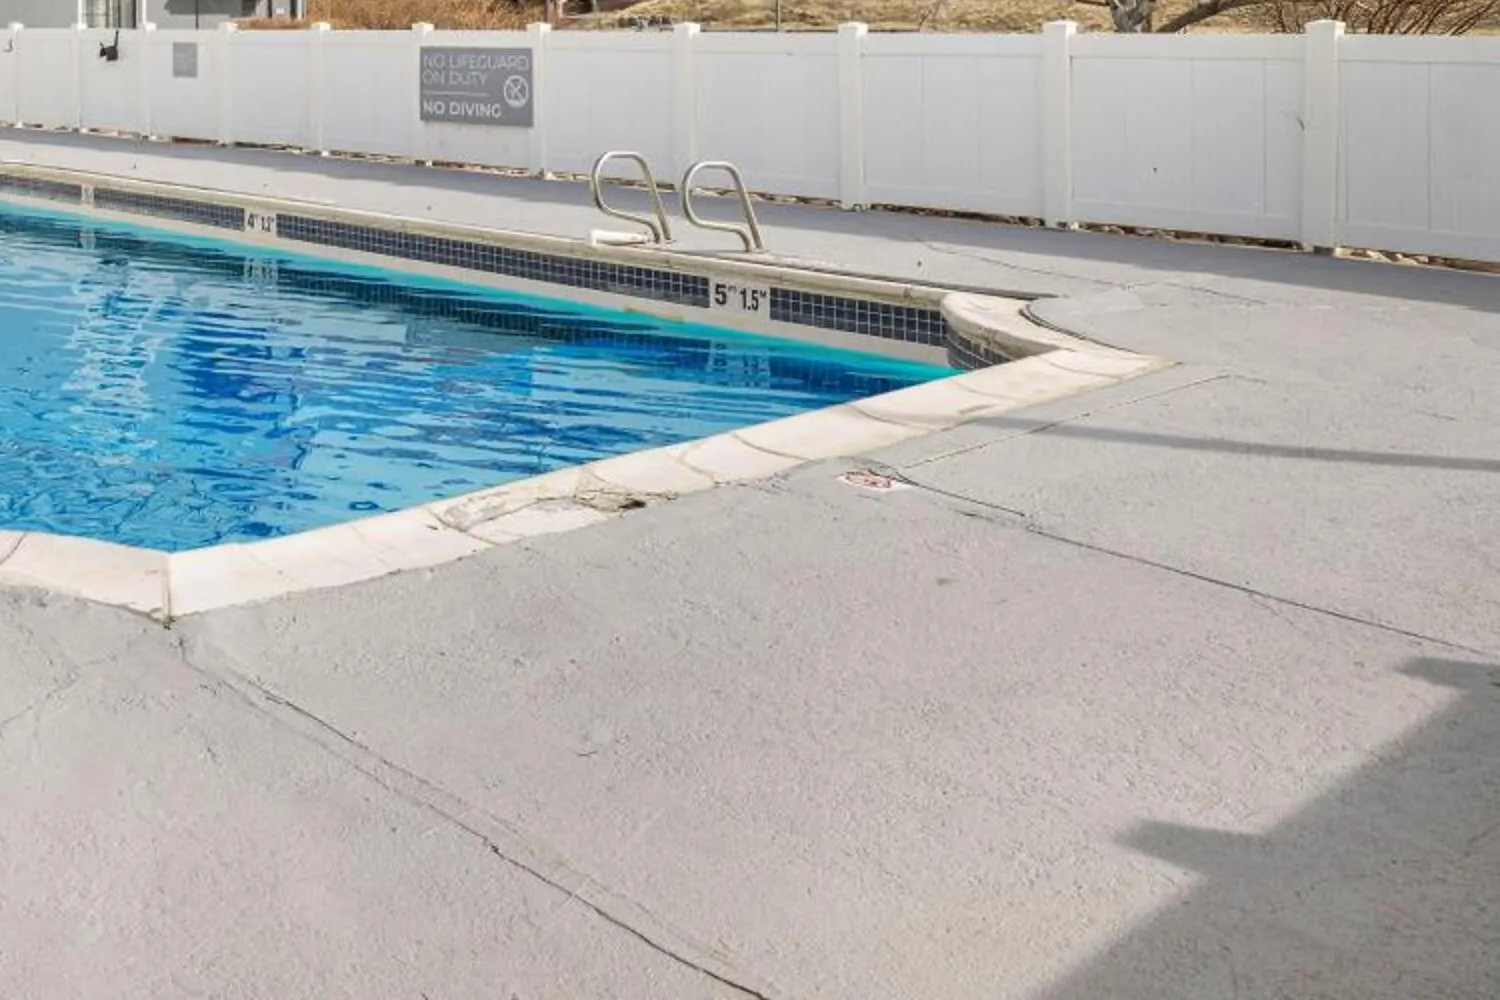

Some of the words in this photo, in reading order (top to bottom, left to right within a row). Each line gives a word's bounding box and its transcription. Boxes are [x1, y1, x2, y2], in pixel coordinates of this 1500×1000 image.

[423, 55, 445, 69] NO
[449, 55, 529, 71] LIFEGUARD
[422, 70, 445, 84] ON
[449, 71, 488, 86] DUTY
[423, 101, 445, 115] NO
[449, 102, 501, 118] DIVING
